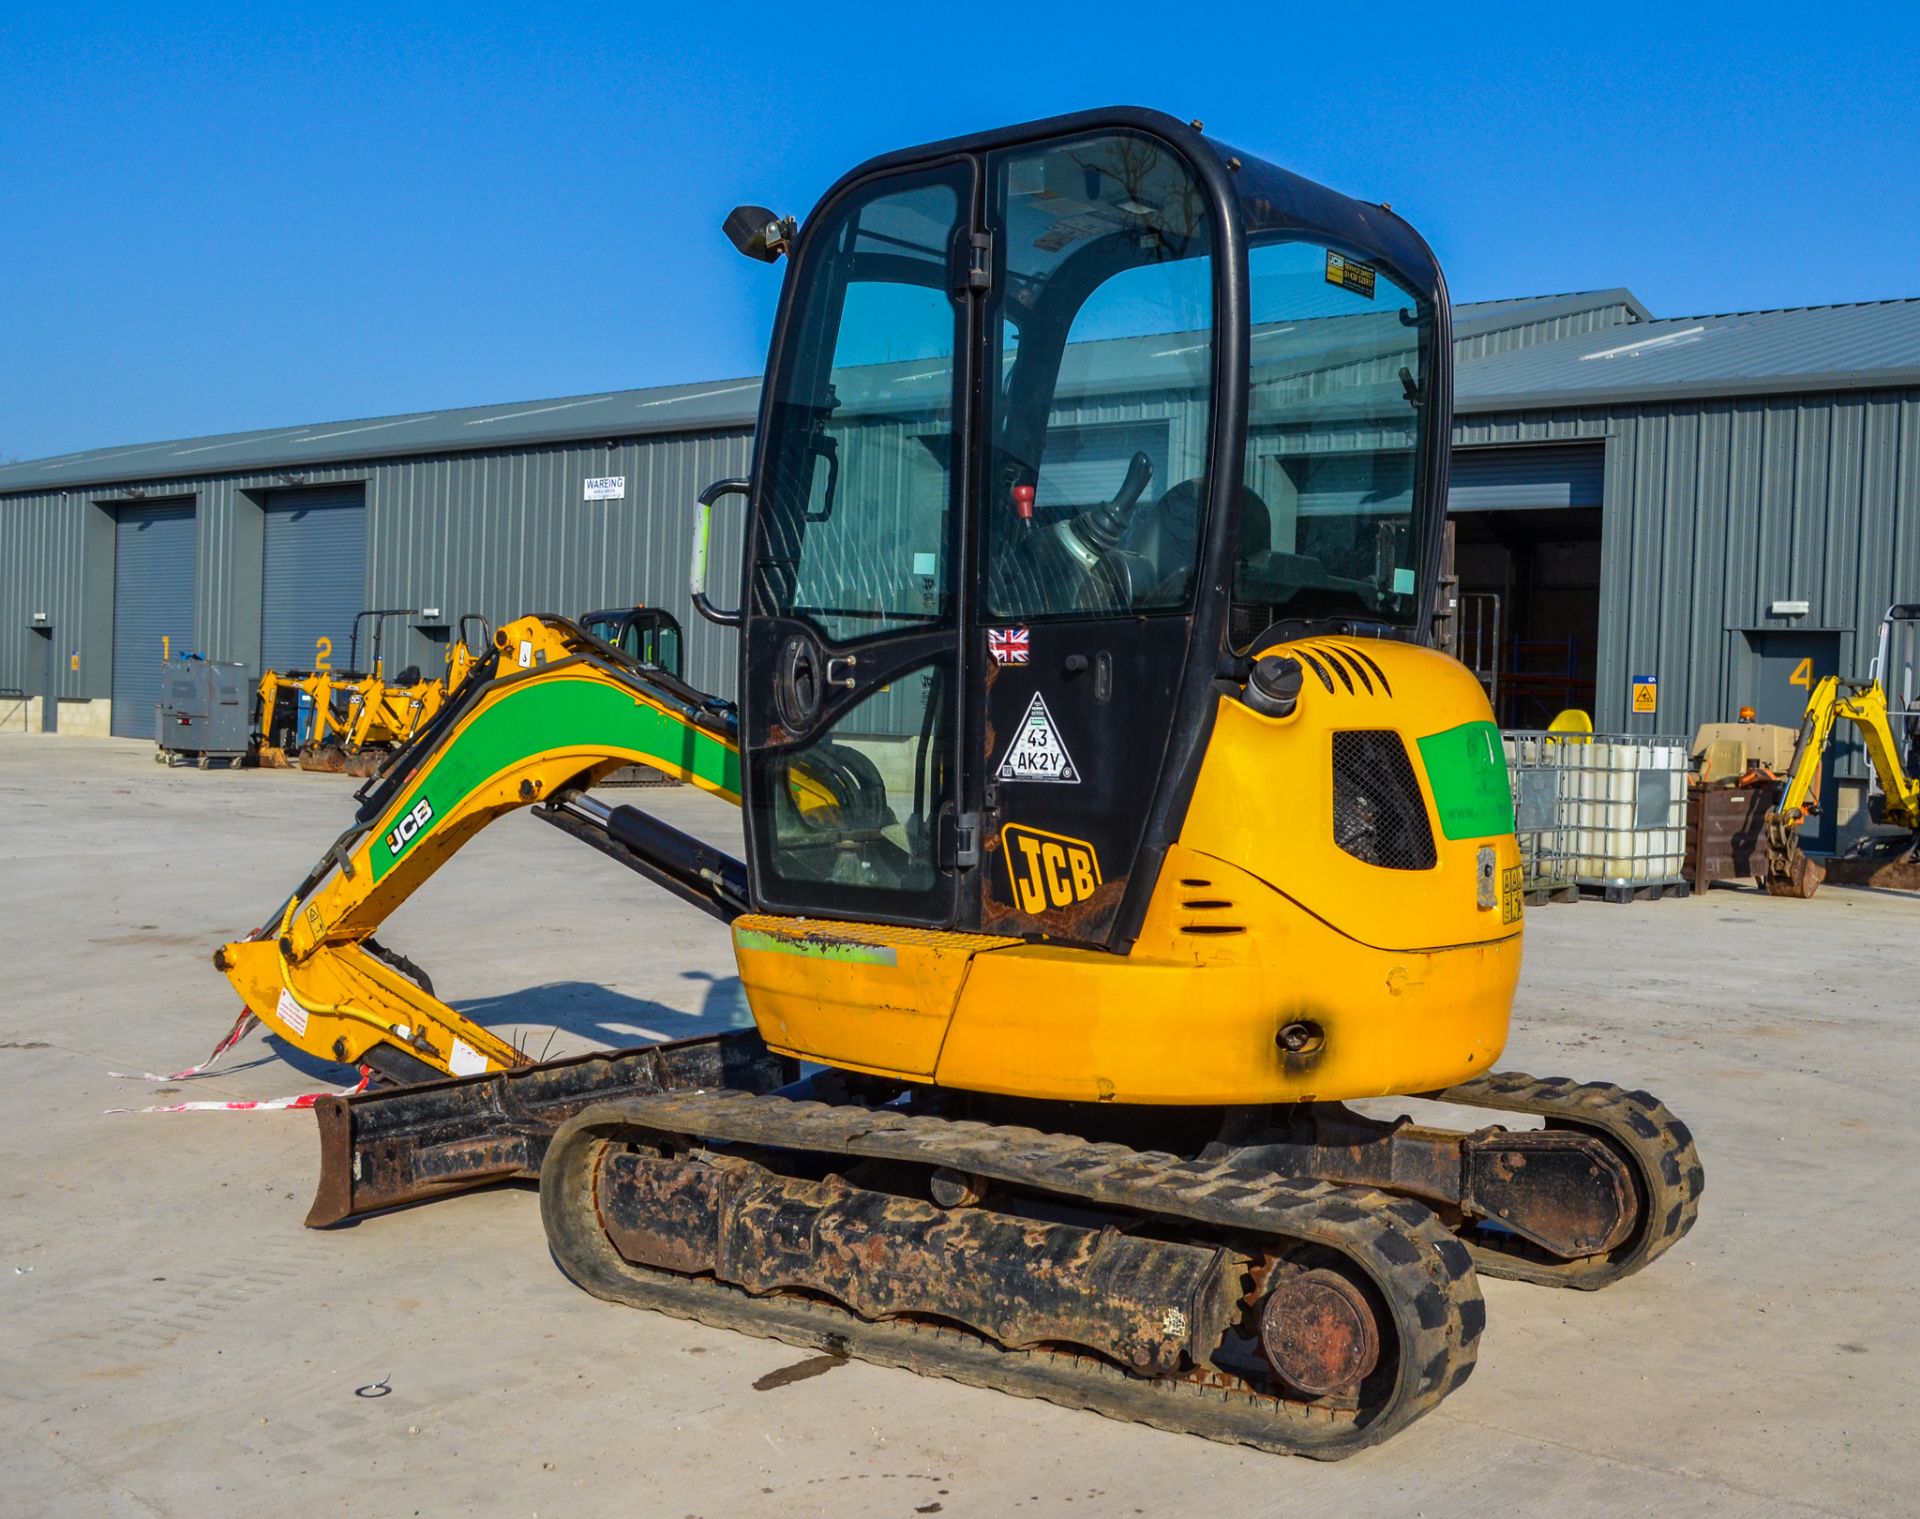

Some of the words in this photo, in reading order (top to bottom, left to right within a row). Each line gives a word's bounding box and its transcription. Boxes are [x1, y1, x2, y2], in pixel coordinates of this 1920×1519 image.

[1329, 254, 1344, 267] JCB
[587, 478, 623, 489] WAREING
[162, 636, 169, 660] 1
[316, 636, 332, 669] 2
[1789, 657, 1813, 691] 4
[1027, 728, 1048, 747] 43
[1017, 752, 1060, 771] AK2Y
[390, 798, 433, 854] JCB
[1018, 835, 1095, 915] JCB
